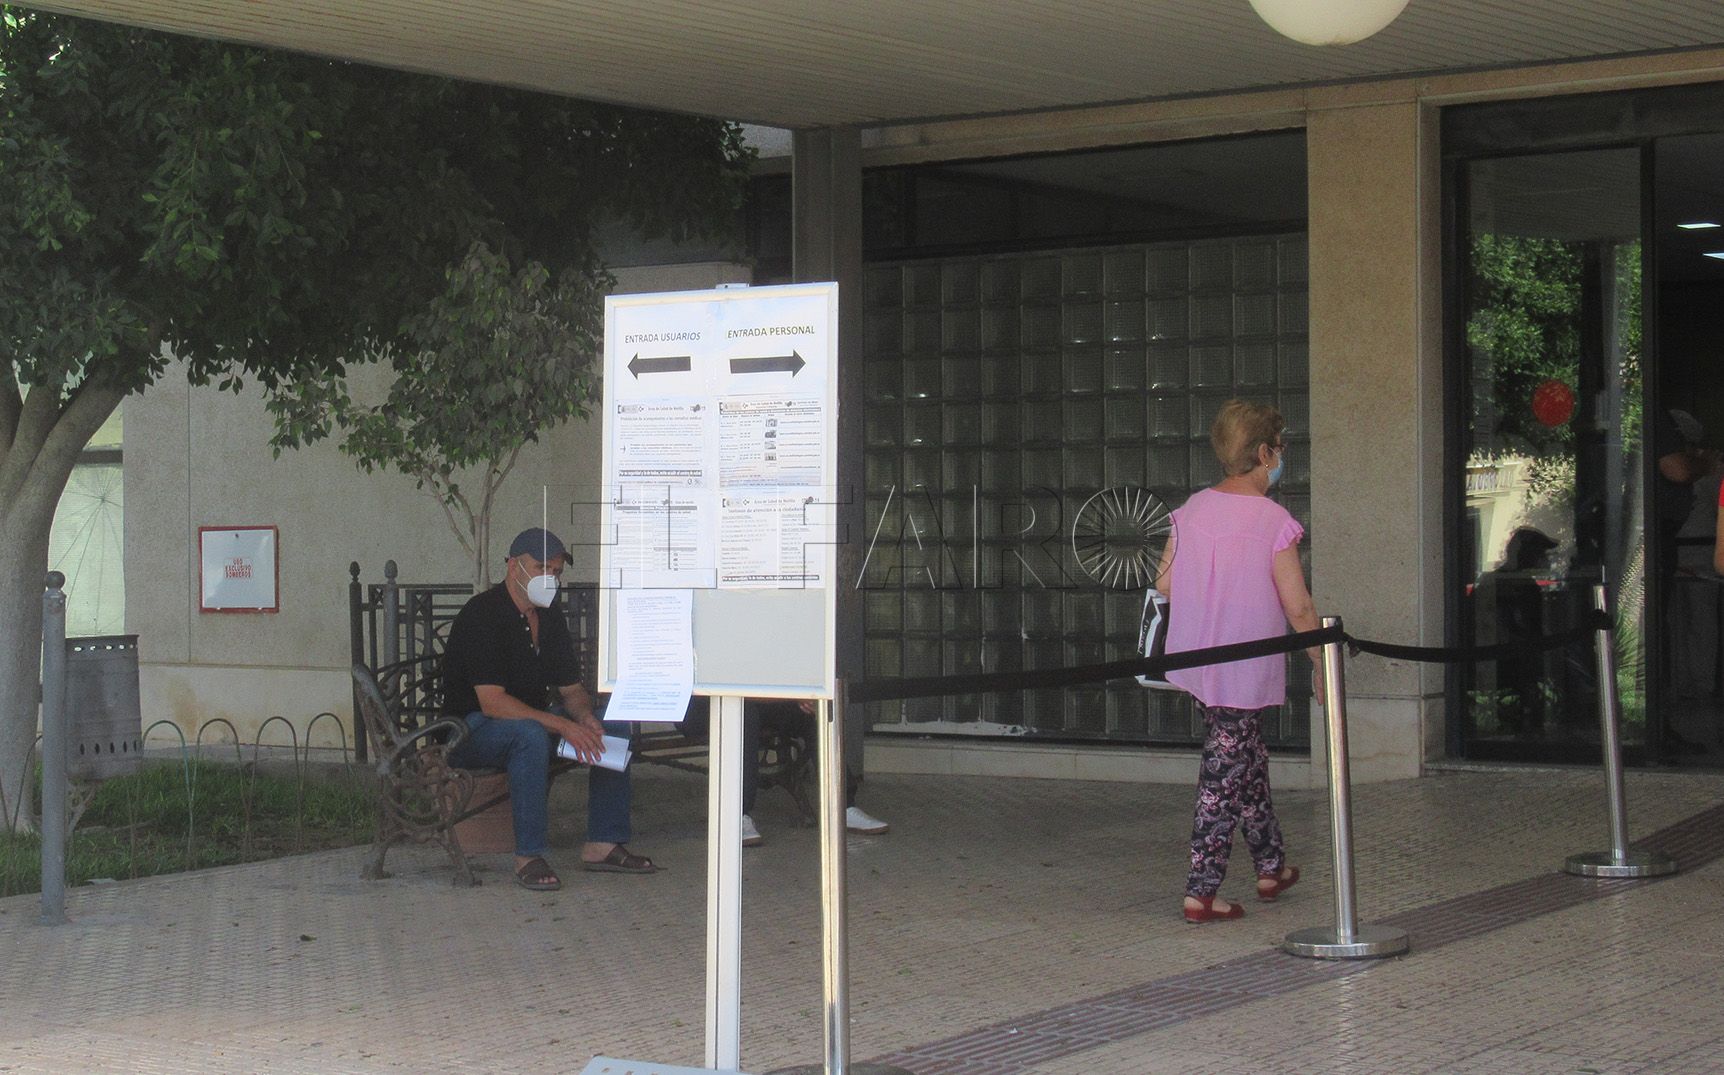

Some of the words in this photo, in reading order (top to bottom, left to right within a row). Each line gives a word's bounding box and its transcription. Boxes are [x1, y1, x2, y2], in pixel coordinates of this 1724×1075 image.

[625, 333, 659, 344] ENTRADA
[660, 331, 701, 342] USUARIOS
[727, 328, 767, 339] ENTRADA
[769, 325, 815, 336] PERSONAL
